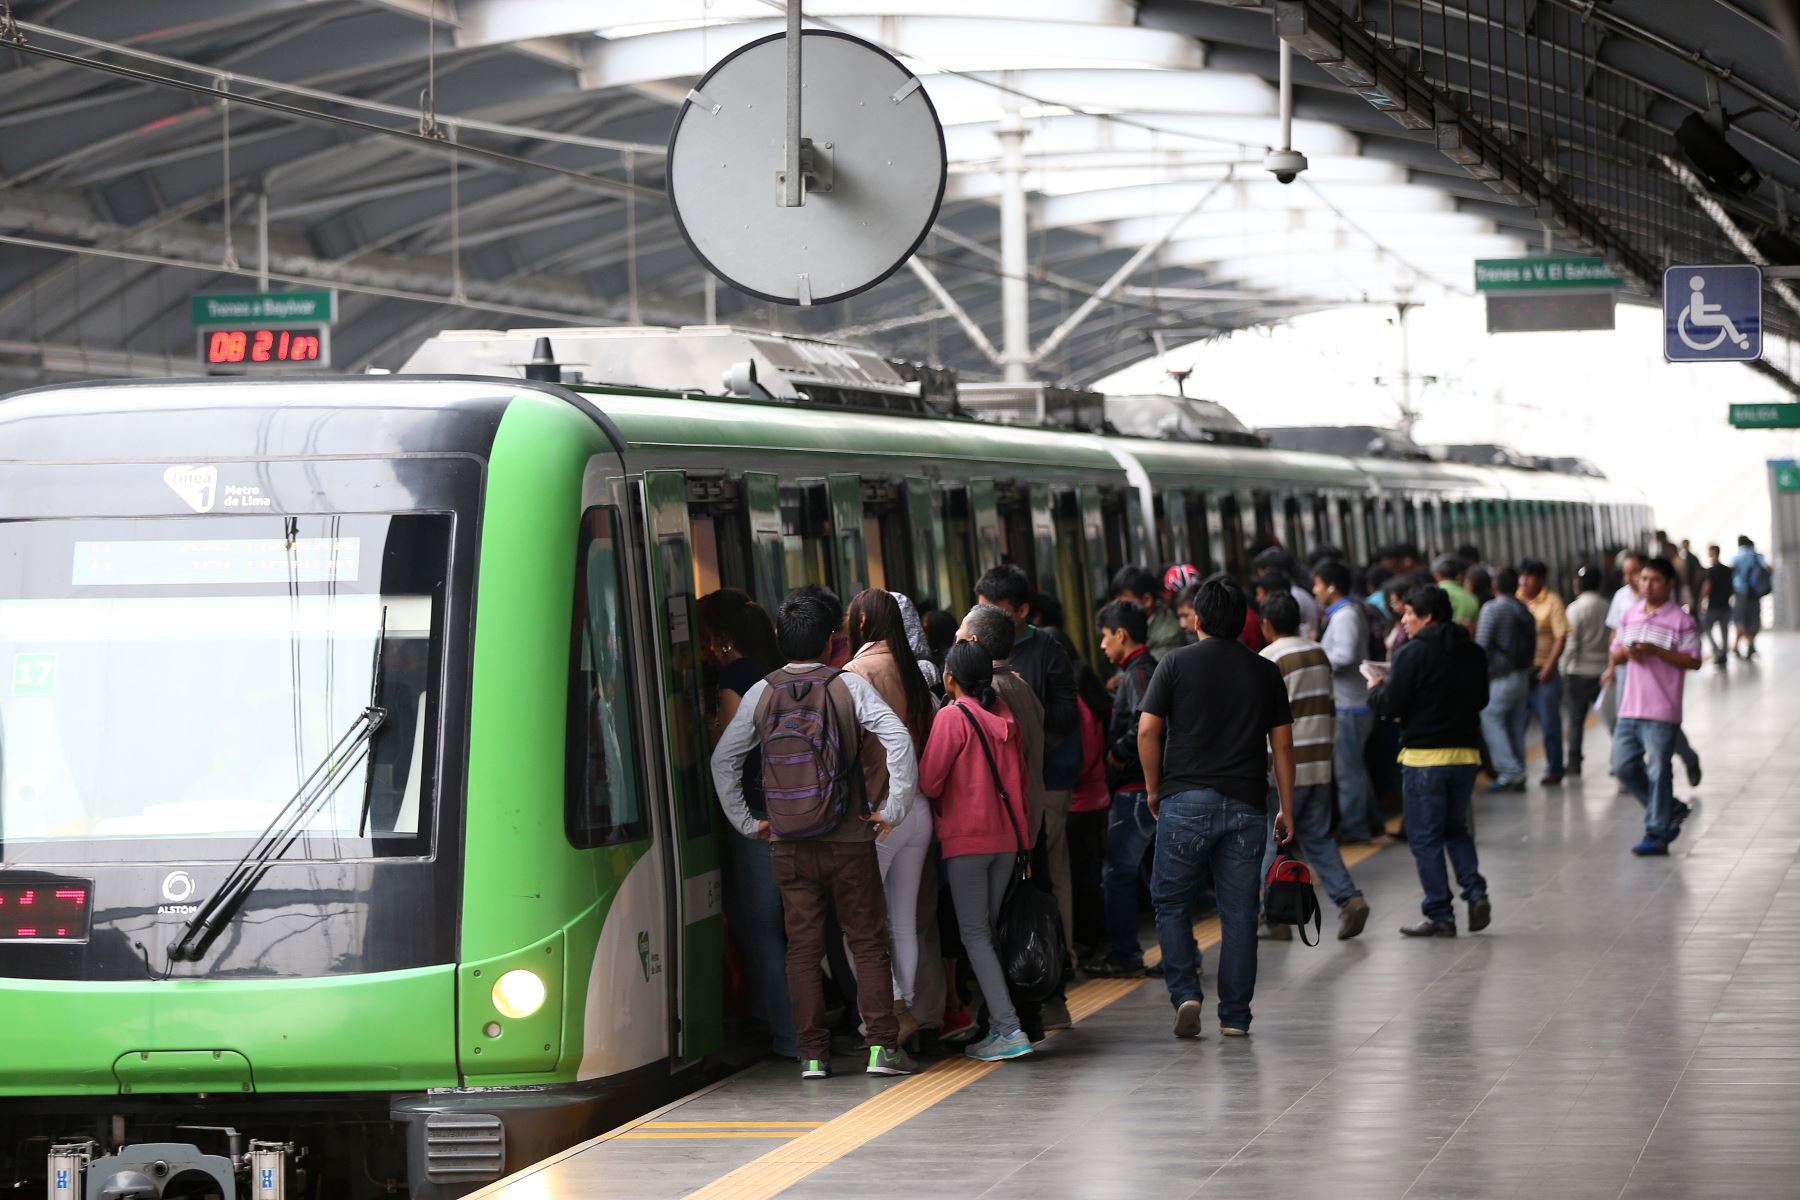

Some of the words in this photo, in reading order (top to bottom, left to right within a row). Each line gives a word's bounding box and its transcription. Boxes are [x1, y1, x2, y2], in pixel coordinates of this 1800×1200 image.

[1477, 265, 1520, 282] Trenes
[1523, 267, 1532, 281] a
[1548, 263, 1562, 280] El
[198, 486, 210, 507] 1
[225, 485, 260, 495] Metro
[224, 495, 240, 507] de
[241, 495, 271, 506] Lima
[17, 660, 53, 687] 17
[157, 904, 197, 915] ALSTOM
